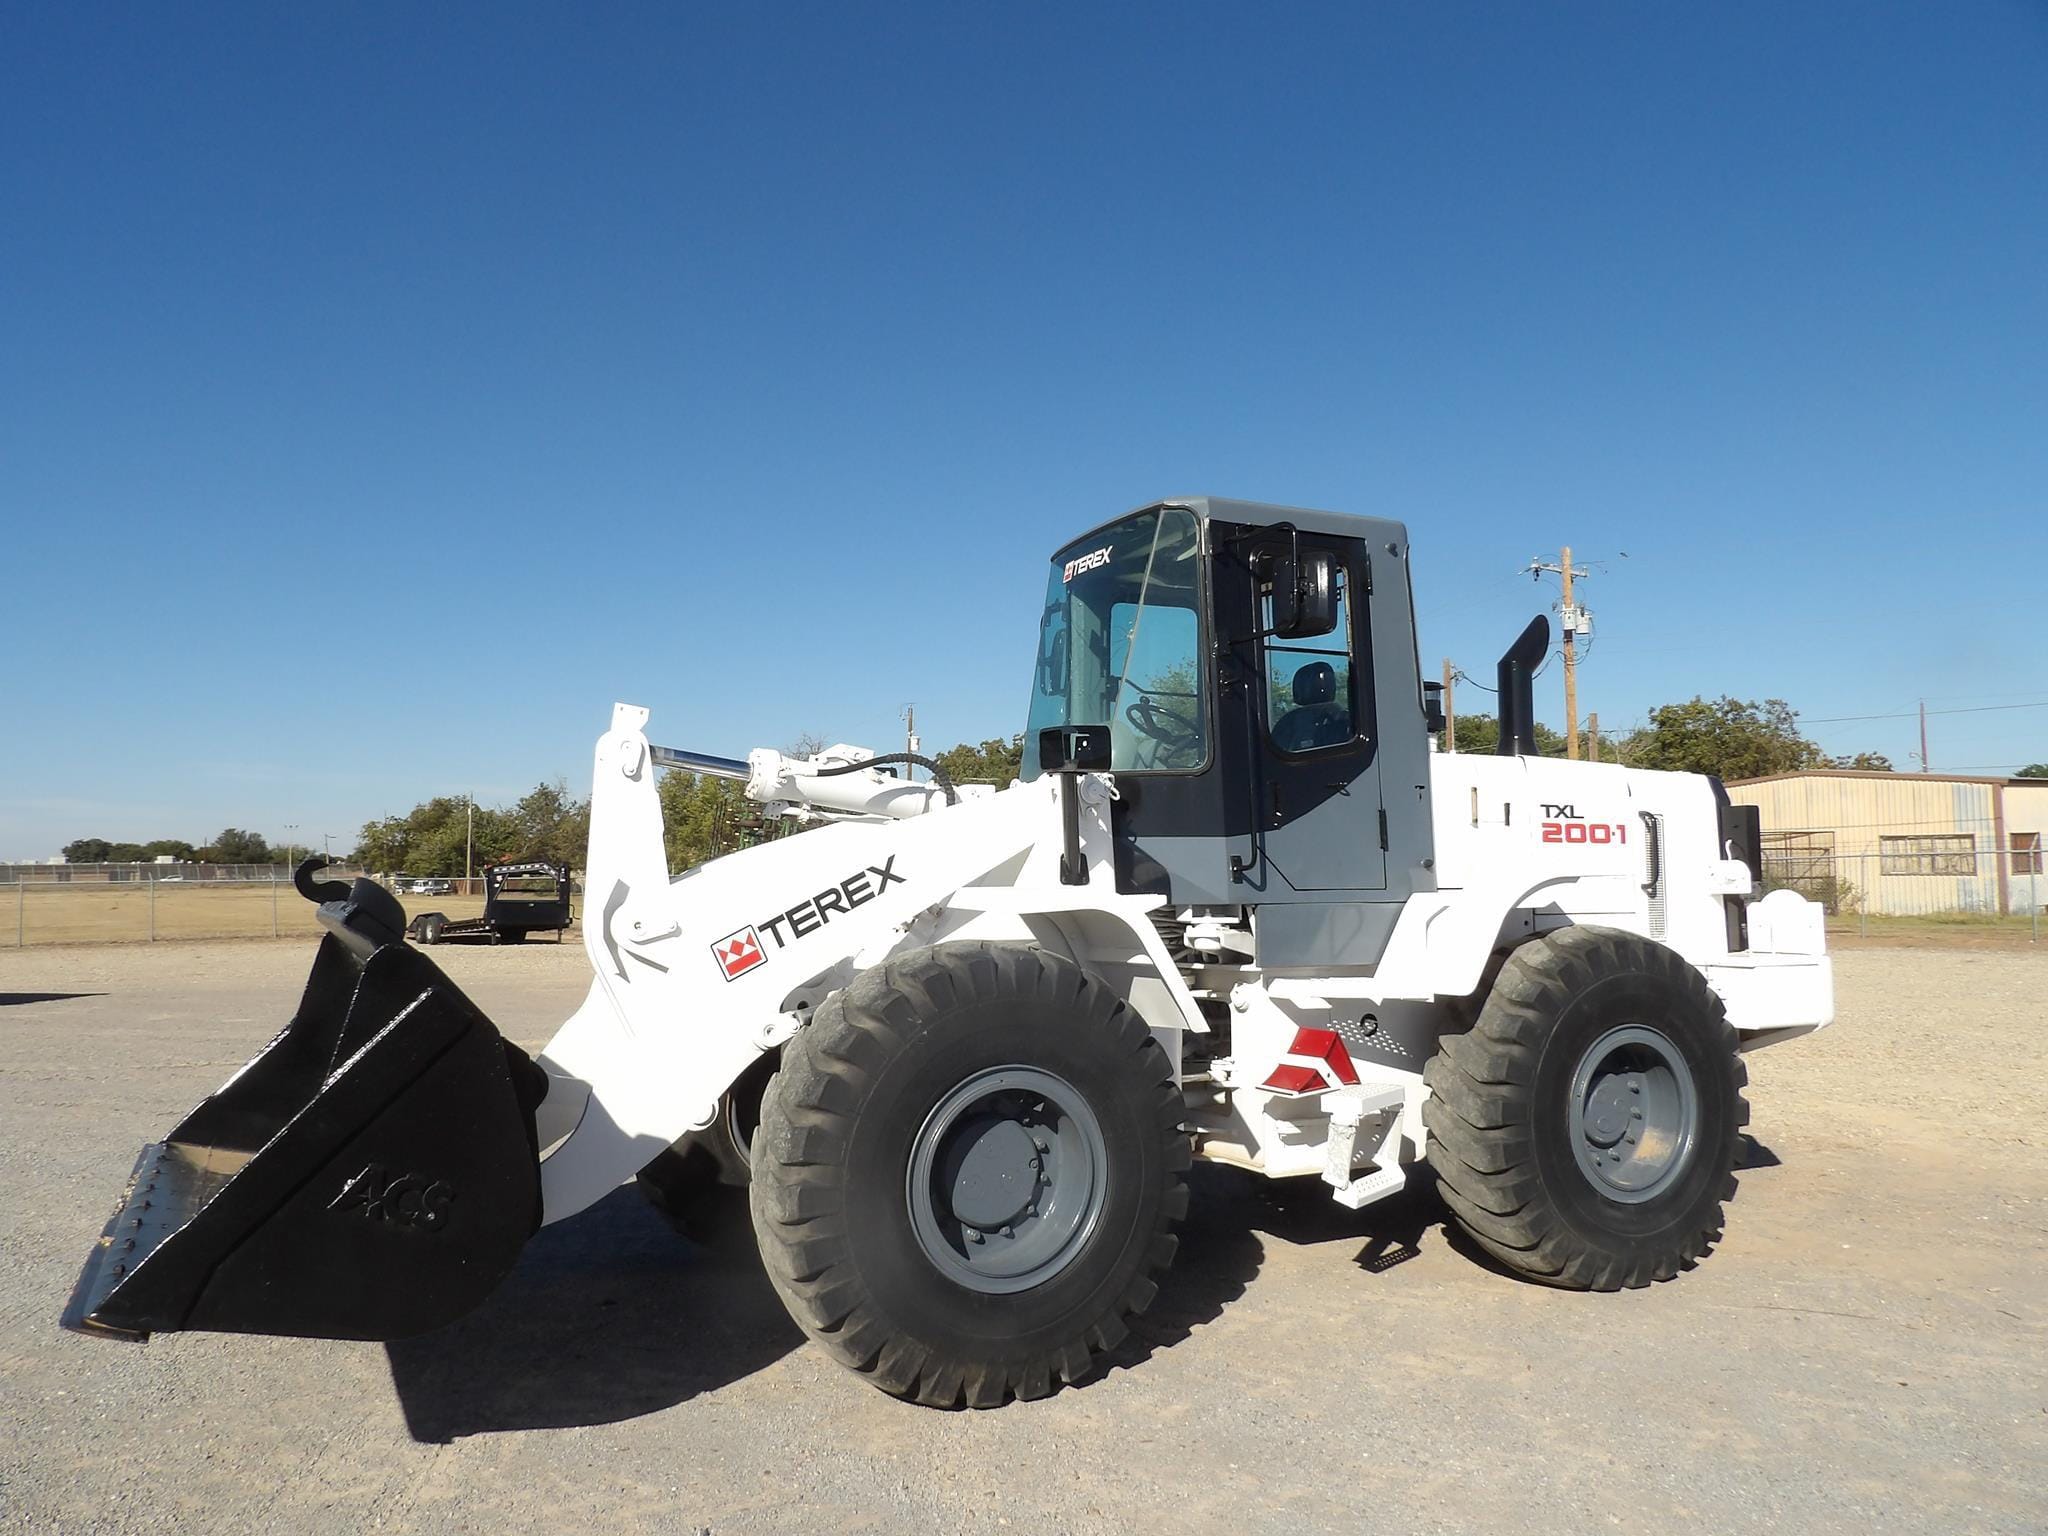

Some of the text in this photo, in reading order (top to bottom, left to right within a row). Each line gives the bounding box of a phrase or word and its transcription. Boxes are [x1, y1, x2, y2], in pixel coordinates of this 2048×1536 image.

[1072, 545, 1114, 577] TEREX
[1540, 804, 1584, 819] TXL
[757, 853, 908, 949] TEREX
